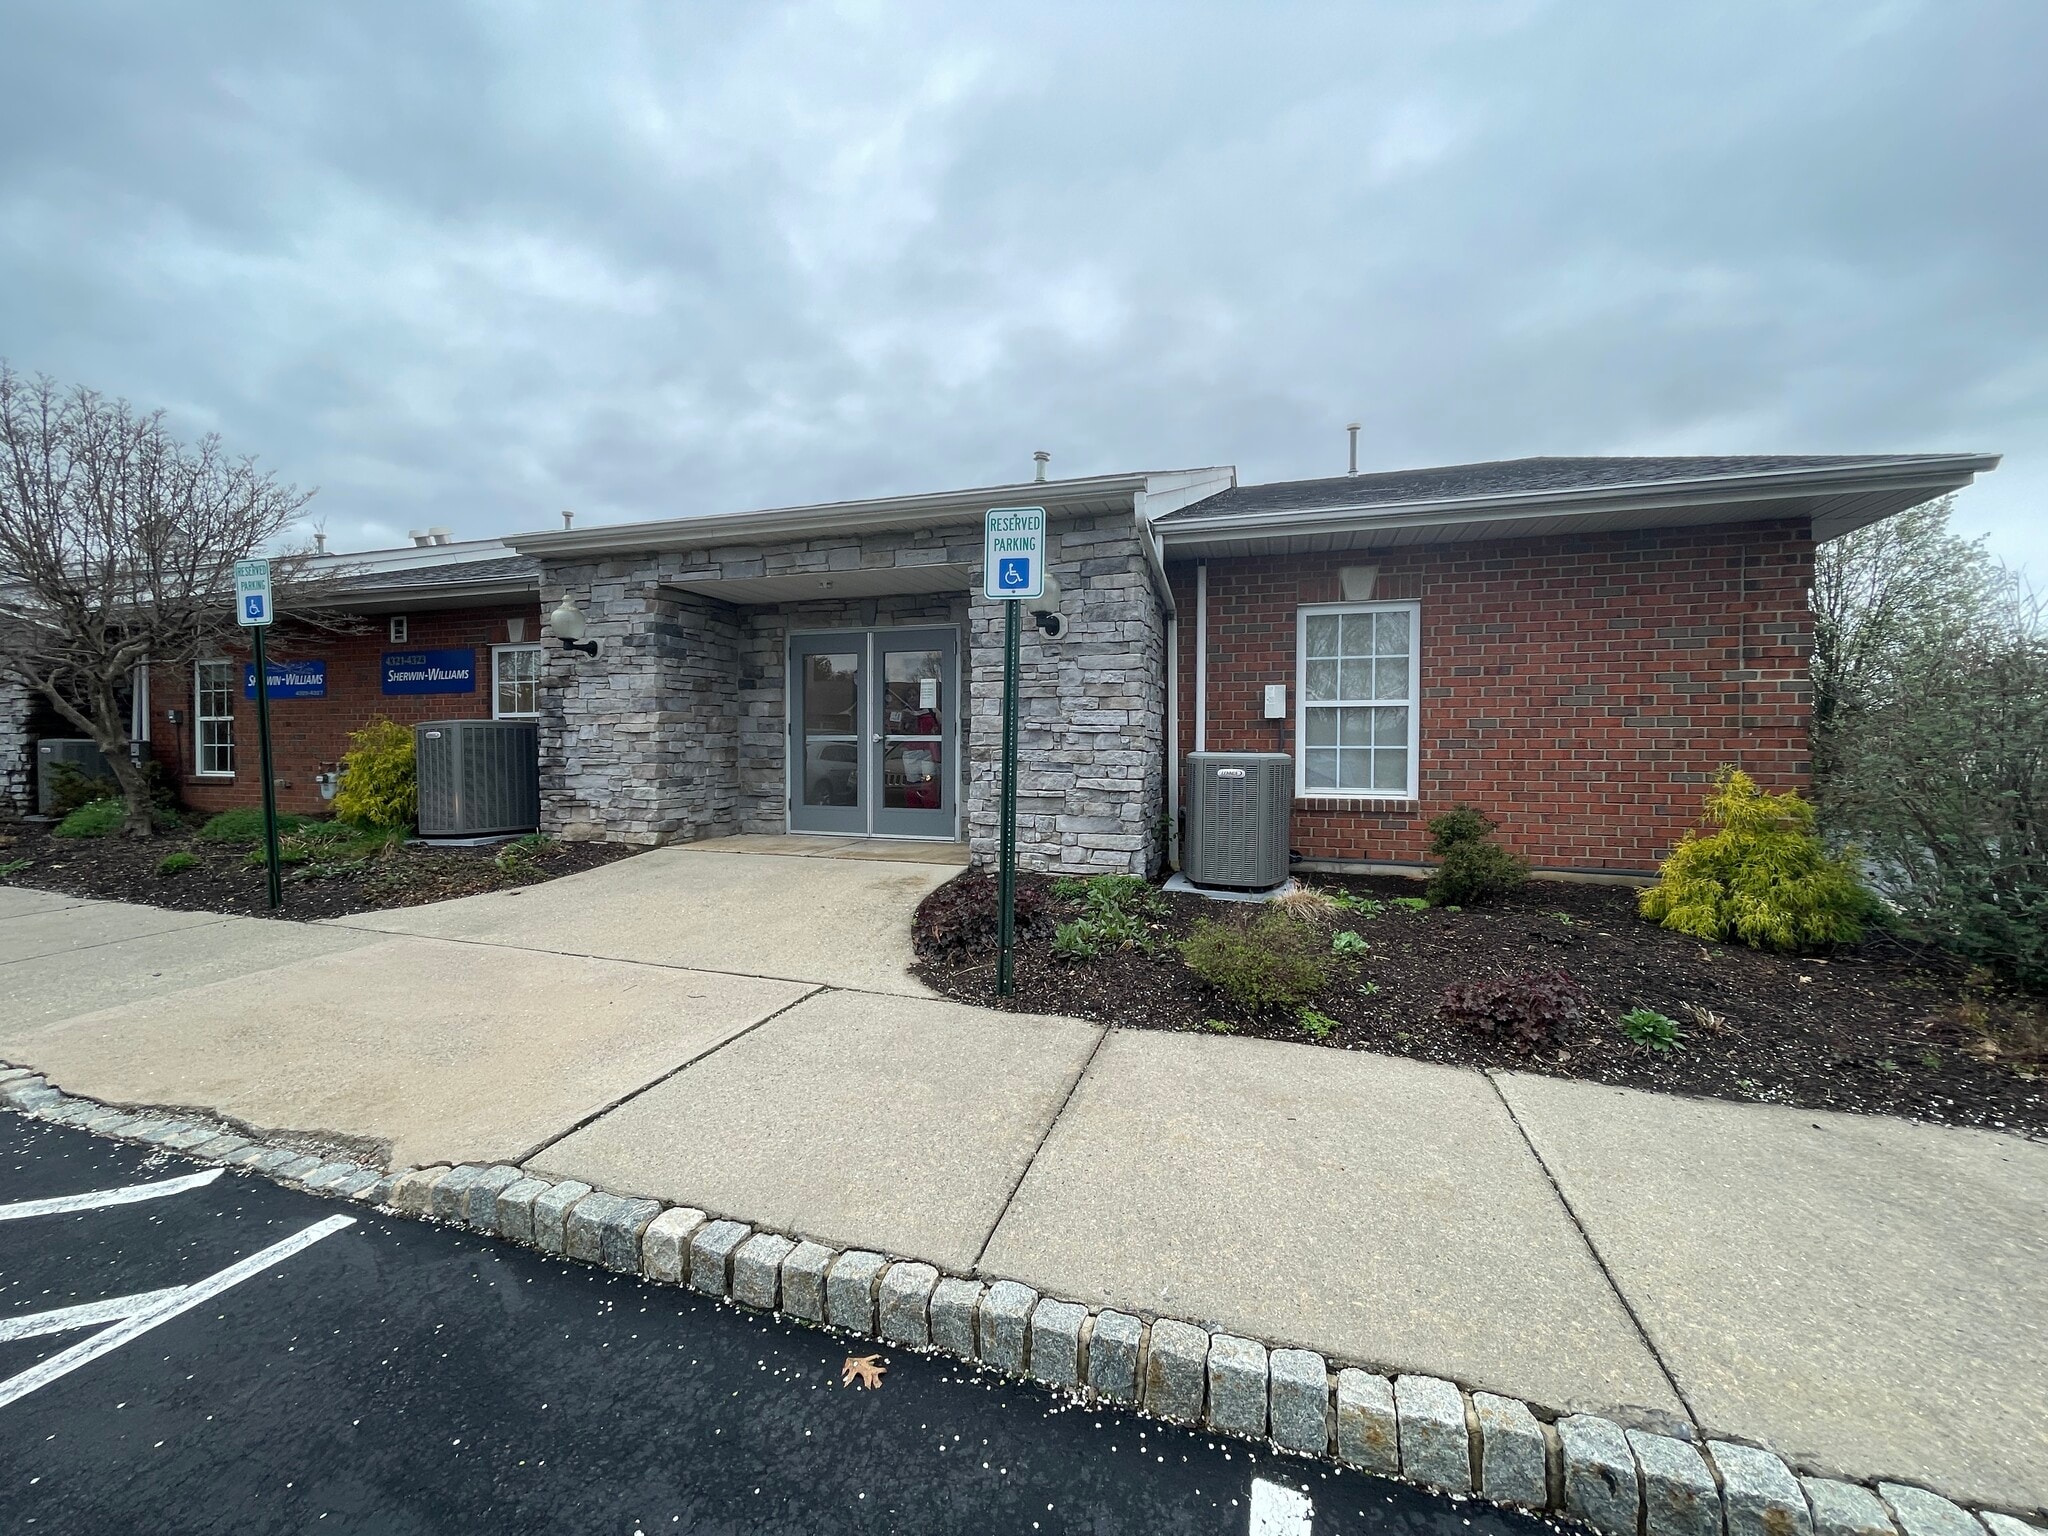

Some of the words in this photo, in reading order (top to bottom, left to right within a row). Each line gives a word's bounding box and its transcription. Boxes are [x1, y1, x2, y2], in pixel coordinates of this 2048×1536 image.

[990, 516, 1040, 532] RESERVED
[994, 537, 1036, 552] PARKING
[237, 564, 267, 577] RESERVED
[241, 579, 266, 591] PARKING
[385, 655, 427, 666] 4321-4323
[247, 673, 324, 687] SWIN-WILLIAMS
[387, 667, 470, 682] SHERWIN-WILLIAMS
